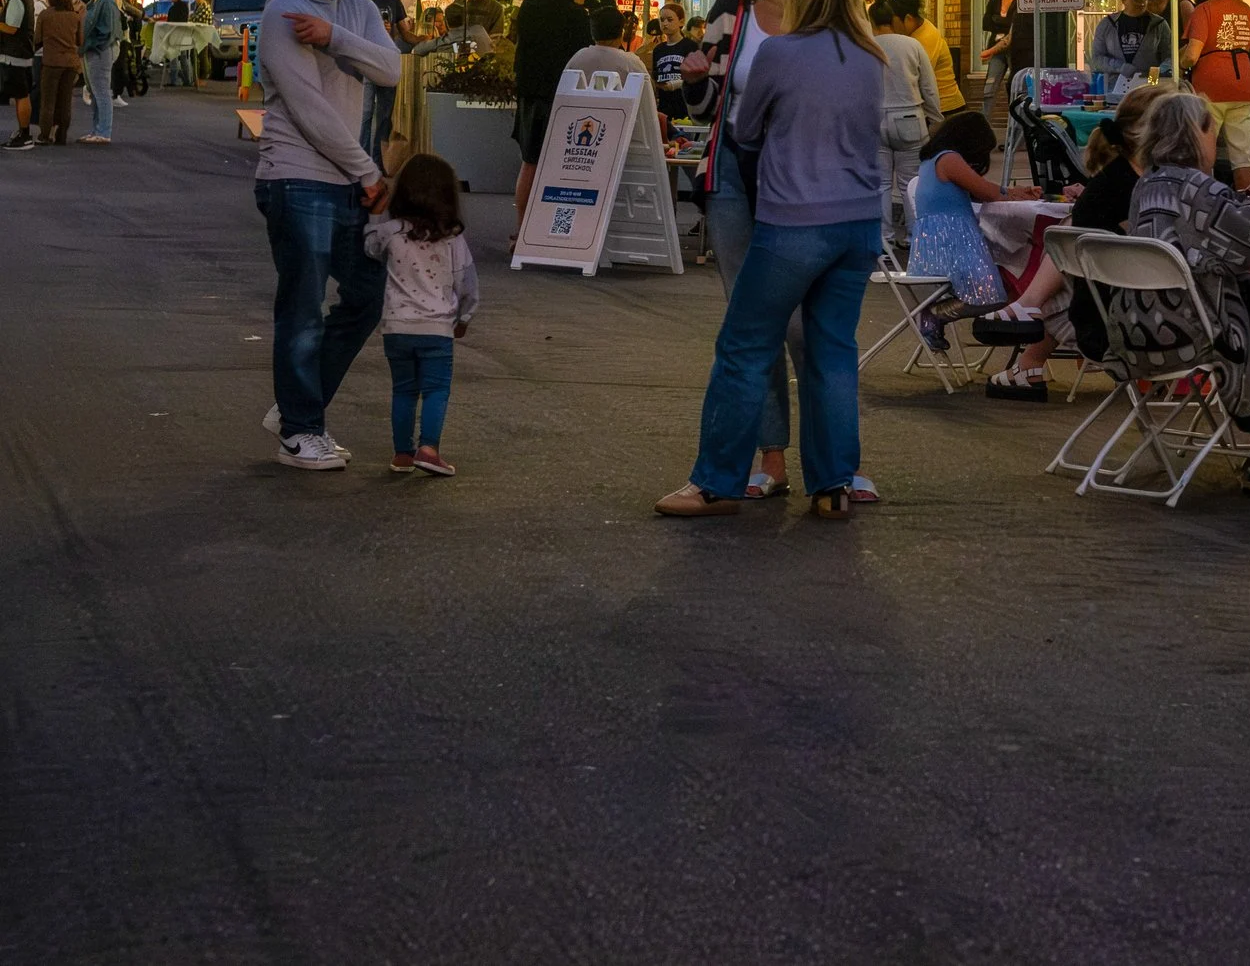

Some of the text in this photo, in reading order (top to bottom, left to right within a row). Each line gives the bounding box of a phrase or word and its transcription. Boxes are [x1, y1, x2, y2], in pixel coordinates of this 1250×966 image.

[564, 148, 598, 158] MESSIAH
[563, 157, 595, 165] CHRISTIAN
[562, 164, 592, 172] PRESCHOOL
